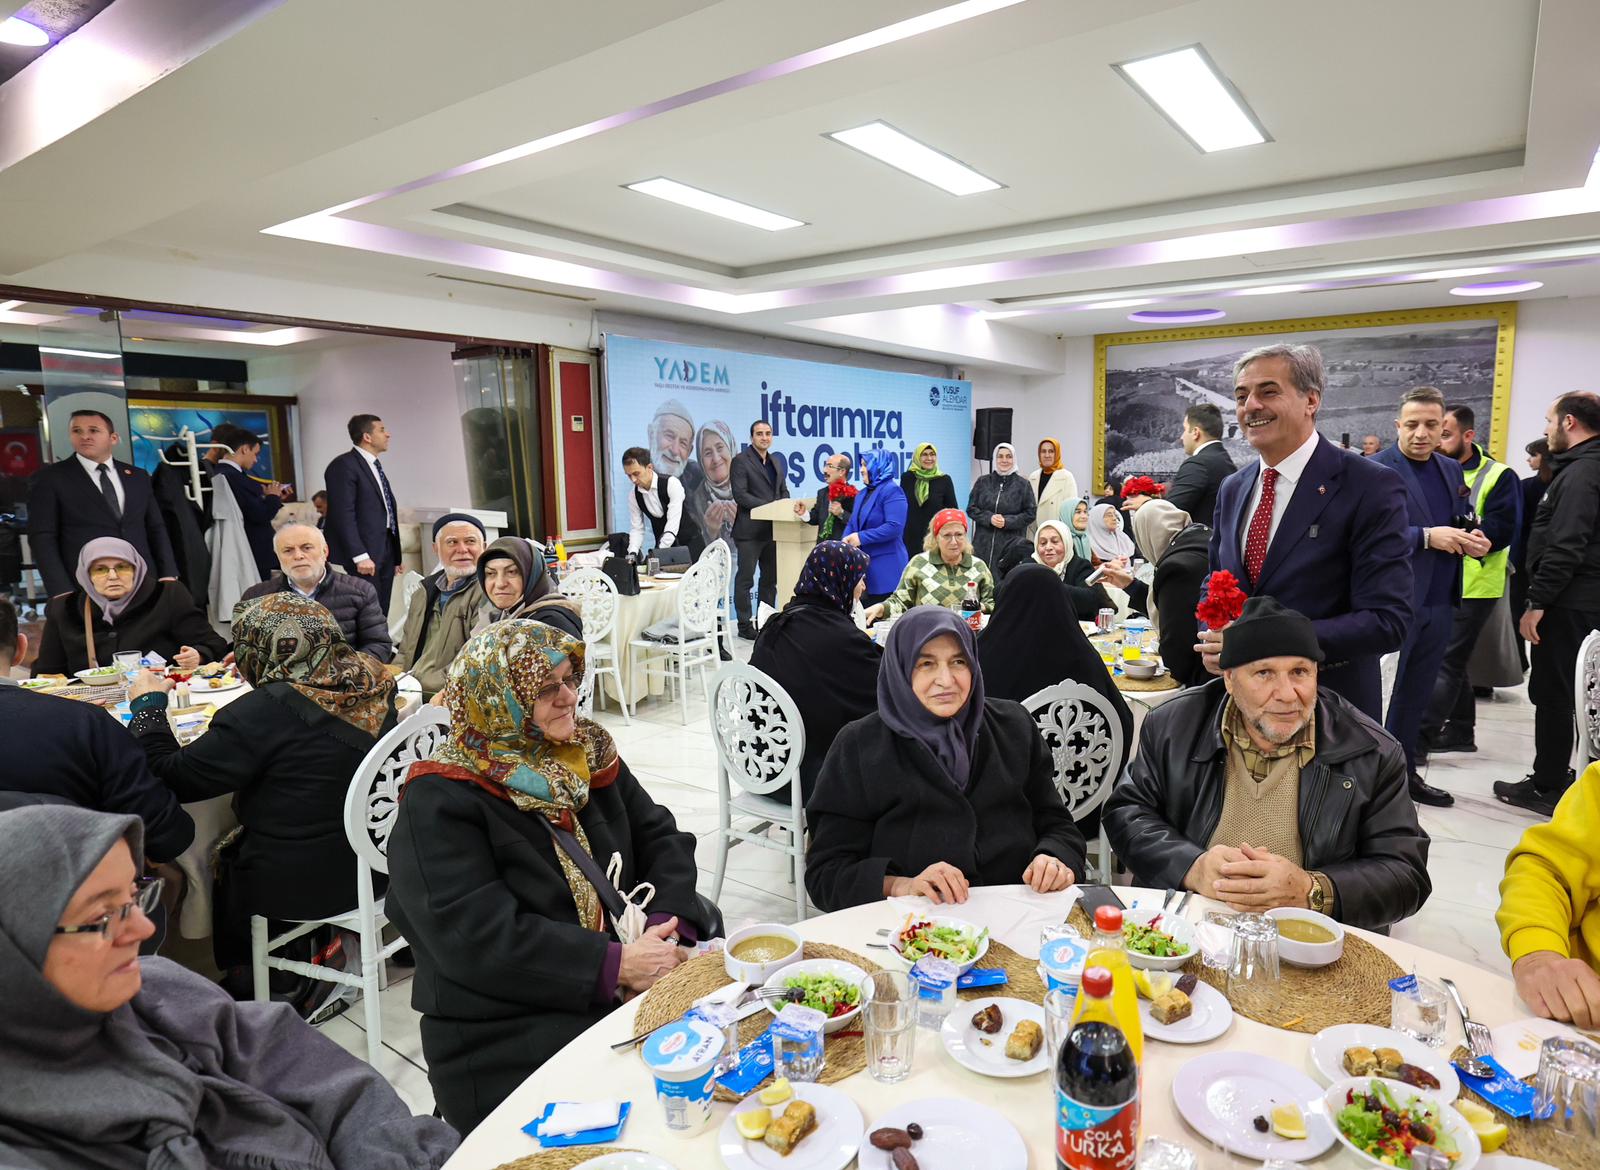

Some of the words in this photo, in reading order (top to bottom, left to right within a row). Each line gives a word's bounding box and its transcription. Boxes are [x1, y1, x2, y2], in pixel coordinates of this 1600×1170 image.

[654, 356, 730, 386] YADEM
[942, 385, 960, 395] YUSUF
[760, 380, 903, 440] İftarımıza
[1061, 1129, 1126, 1158] TURKA
[1084, 1129, 1123, 1141] COLA
